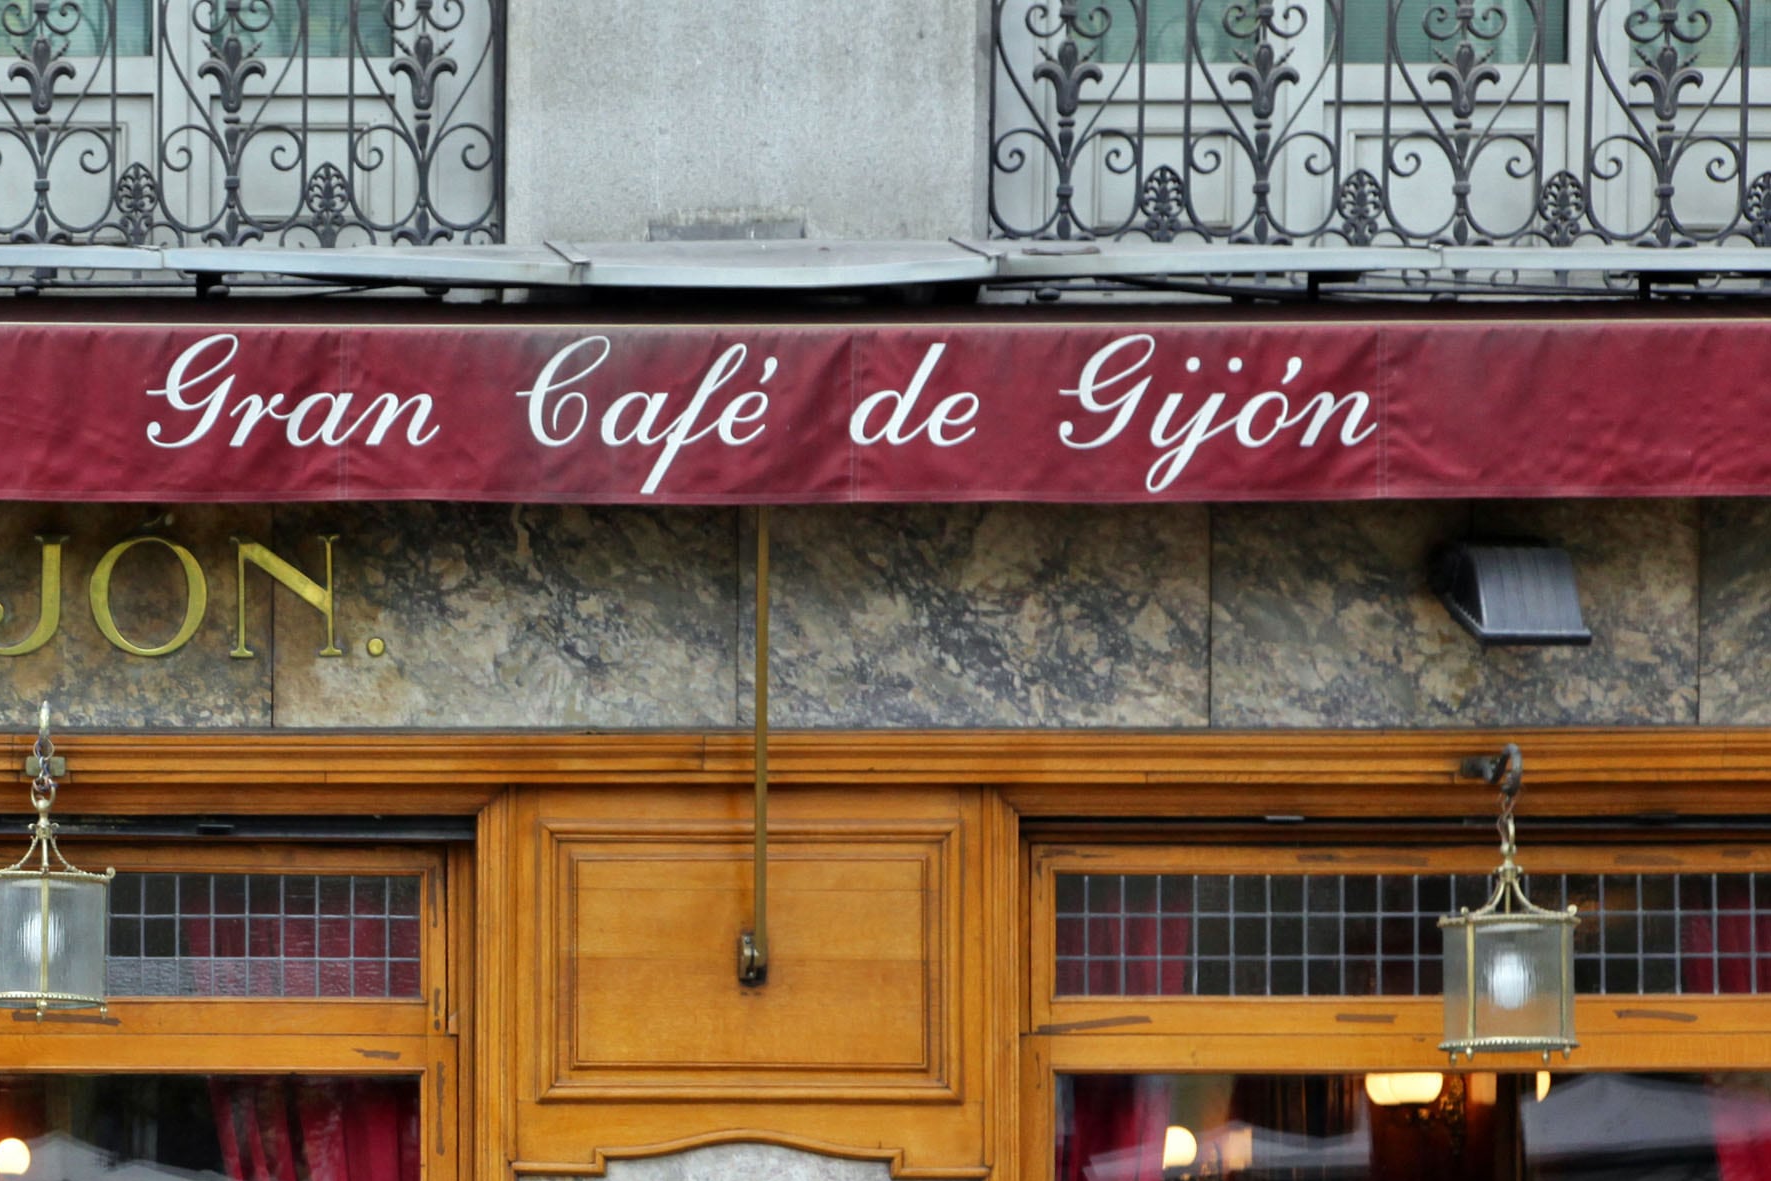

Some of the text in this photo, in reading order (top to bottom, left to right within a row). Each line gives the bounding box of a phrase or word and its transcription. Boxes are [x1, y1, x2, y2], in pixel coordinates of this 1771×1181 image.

[146, 333, 1378, 494] Gran Café de Gijón
